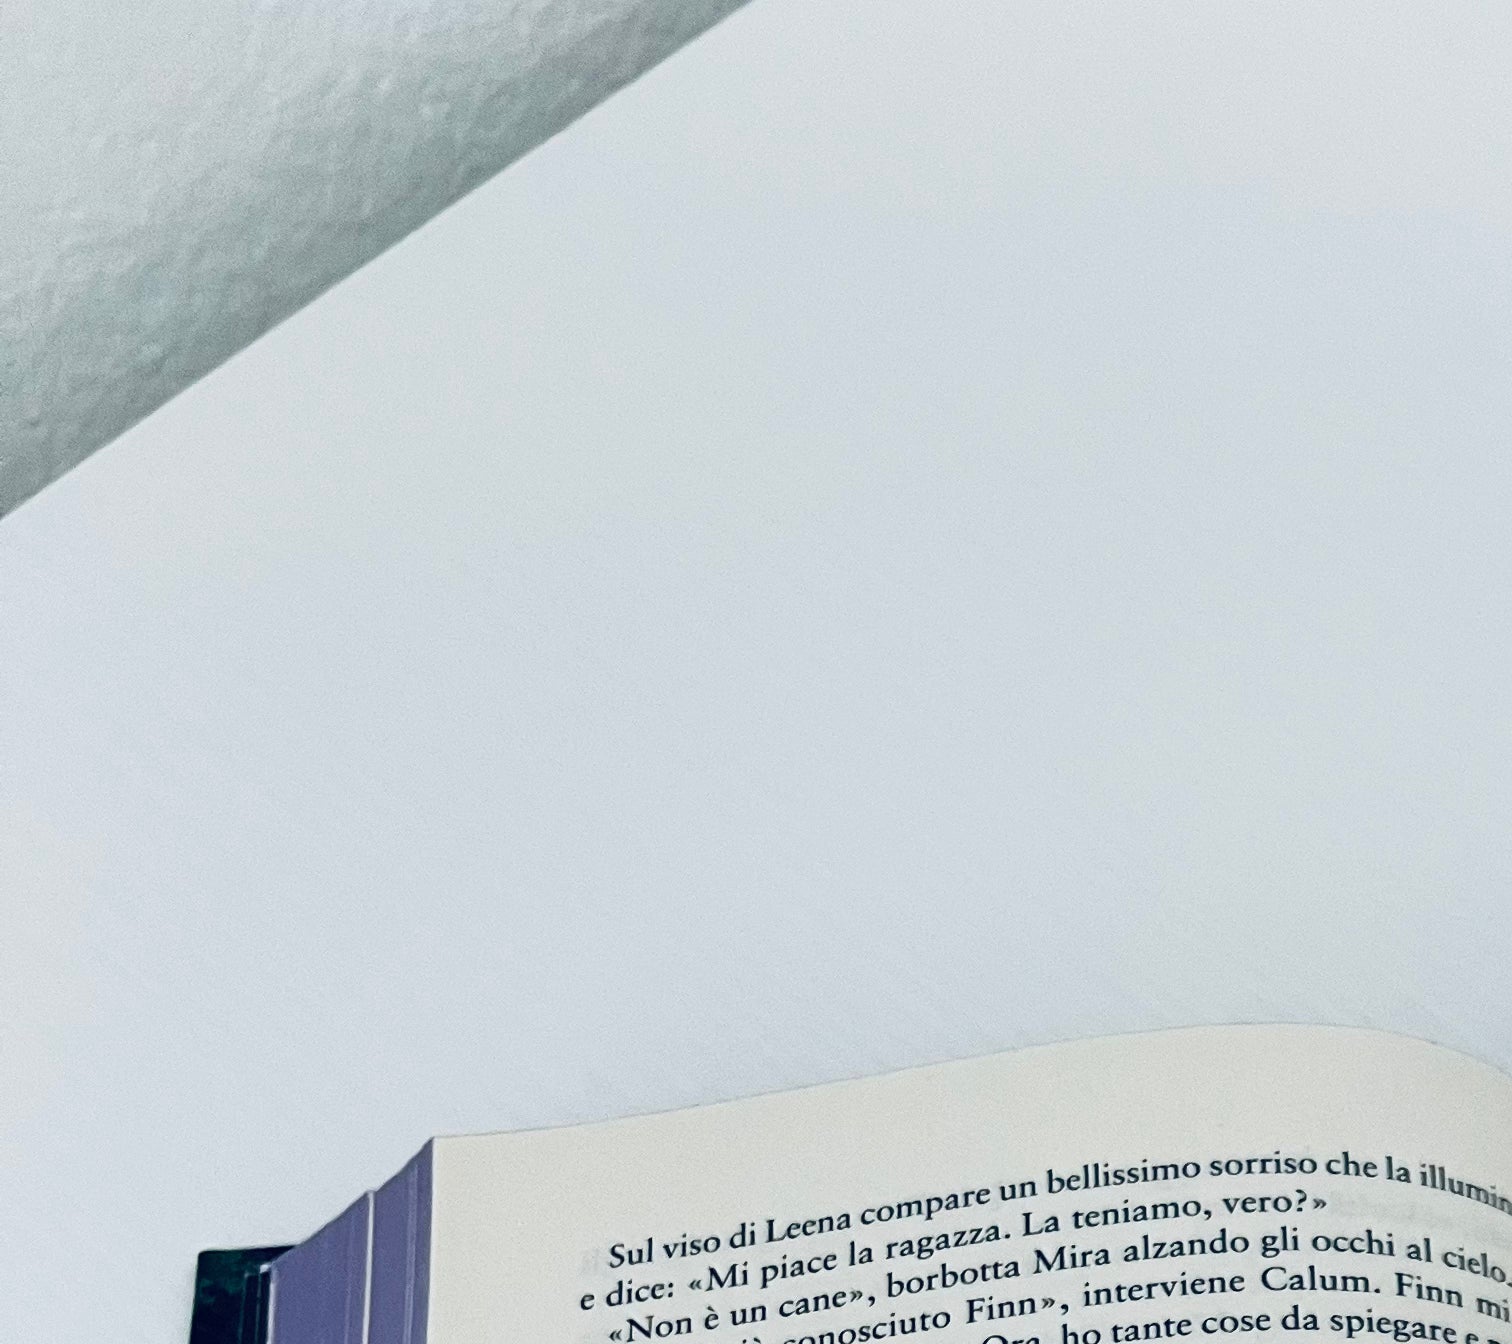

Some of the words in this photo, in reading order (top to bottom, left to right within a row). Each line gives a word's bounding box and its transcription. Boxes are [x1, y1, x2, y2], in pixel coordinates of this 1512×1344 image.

[607, 1236, 654, 1269] Sul
[662, 1232, 721, 1260] viso
[728, 1221, 756, 1250] di
[764, 1212, 852, 1244] Leena
[859, 1188, 991, 1226] compare
[998, 1177, 1039, 1202] un
[1046, 1159, 1202, 1196] bellissimo
[1208, 1150, 1319, 1178] sorriso
[1325, 1150, 1379, 1179] che
[1385, 1155, 1412, 1184] la
[703, 1305, 720, 1331] è
[729, 1304, 767, 1327] un
[885, 1260, 1021, 1298] borbotta
[1032, 1244, 1112, 1275] Mira
[1122, 1227, 1250, 1263] alzando
[1260, 1225, 1300, 1259] gli
[1310, 1228, 1396, 1257] occhi
[1405, 1237, 1433, 1263] al
